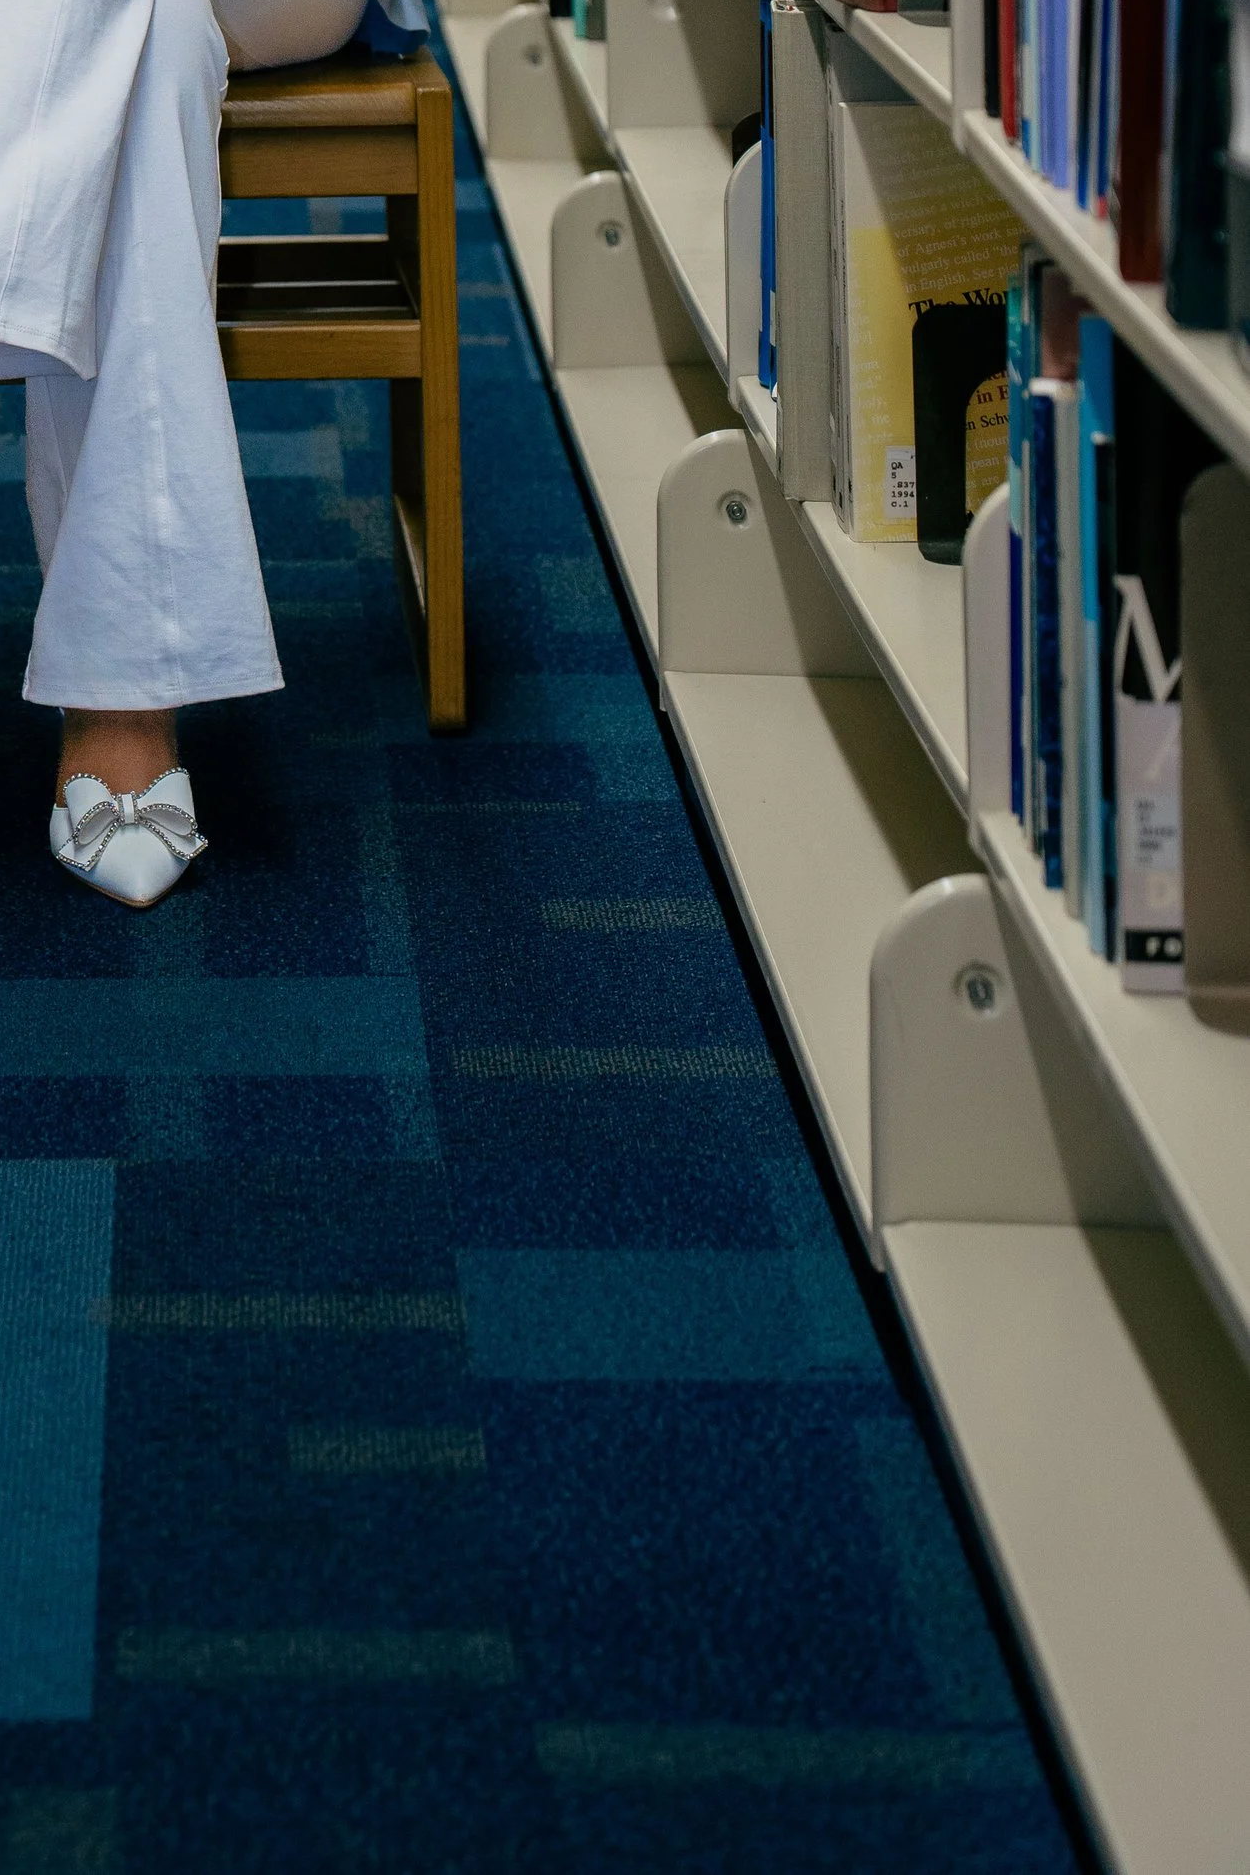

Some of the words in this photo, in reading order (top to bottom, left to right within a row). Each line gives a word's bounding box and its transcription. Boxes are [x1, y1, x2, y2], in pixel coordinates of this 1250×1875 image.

[971, 228, 1002, 243] work
[953, 249, 990, 265] called
[976, 390, 993, 405] in
[891, 461, 903, 470] QA
[891, 490, 915, 498] 1994
